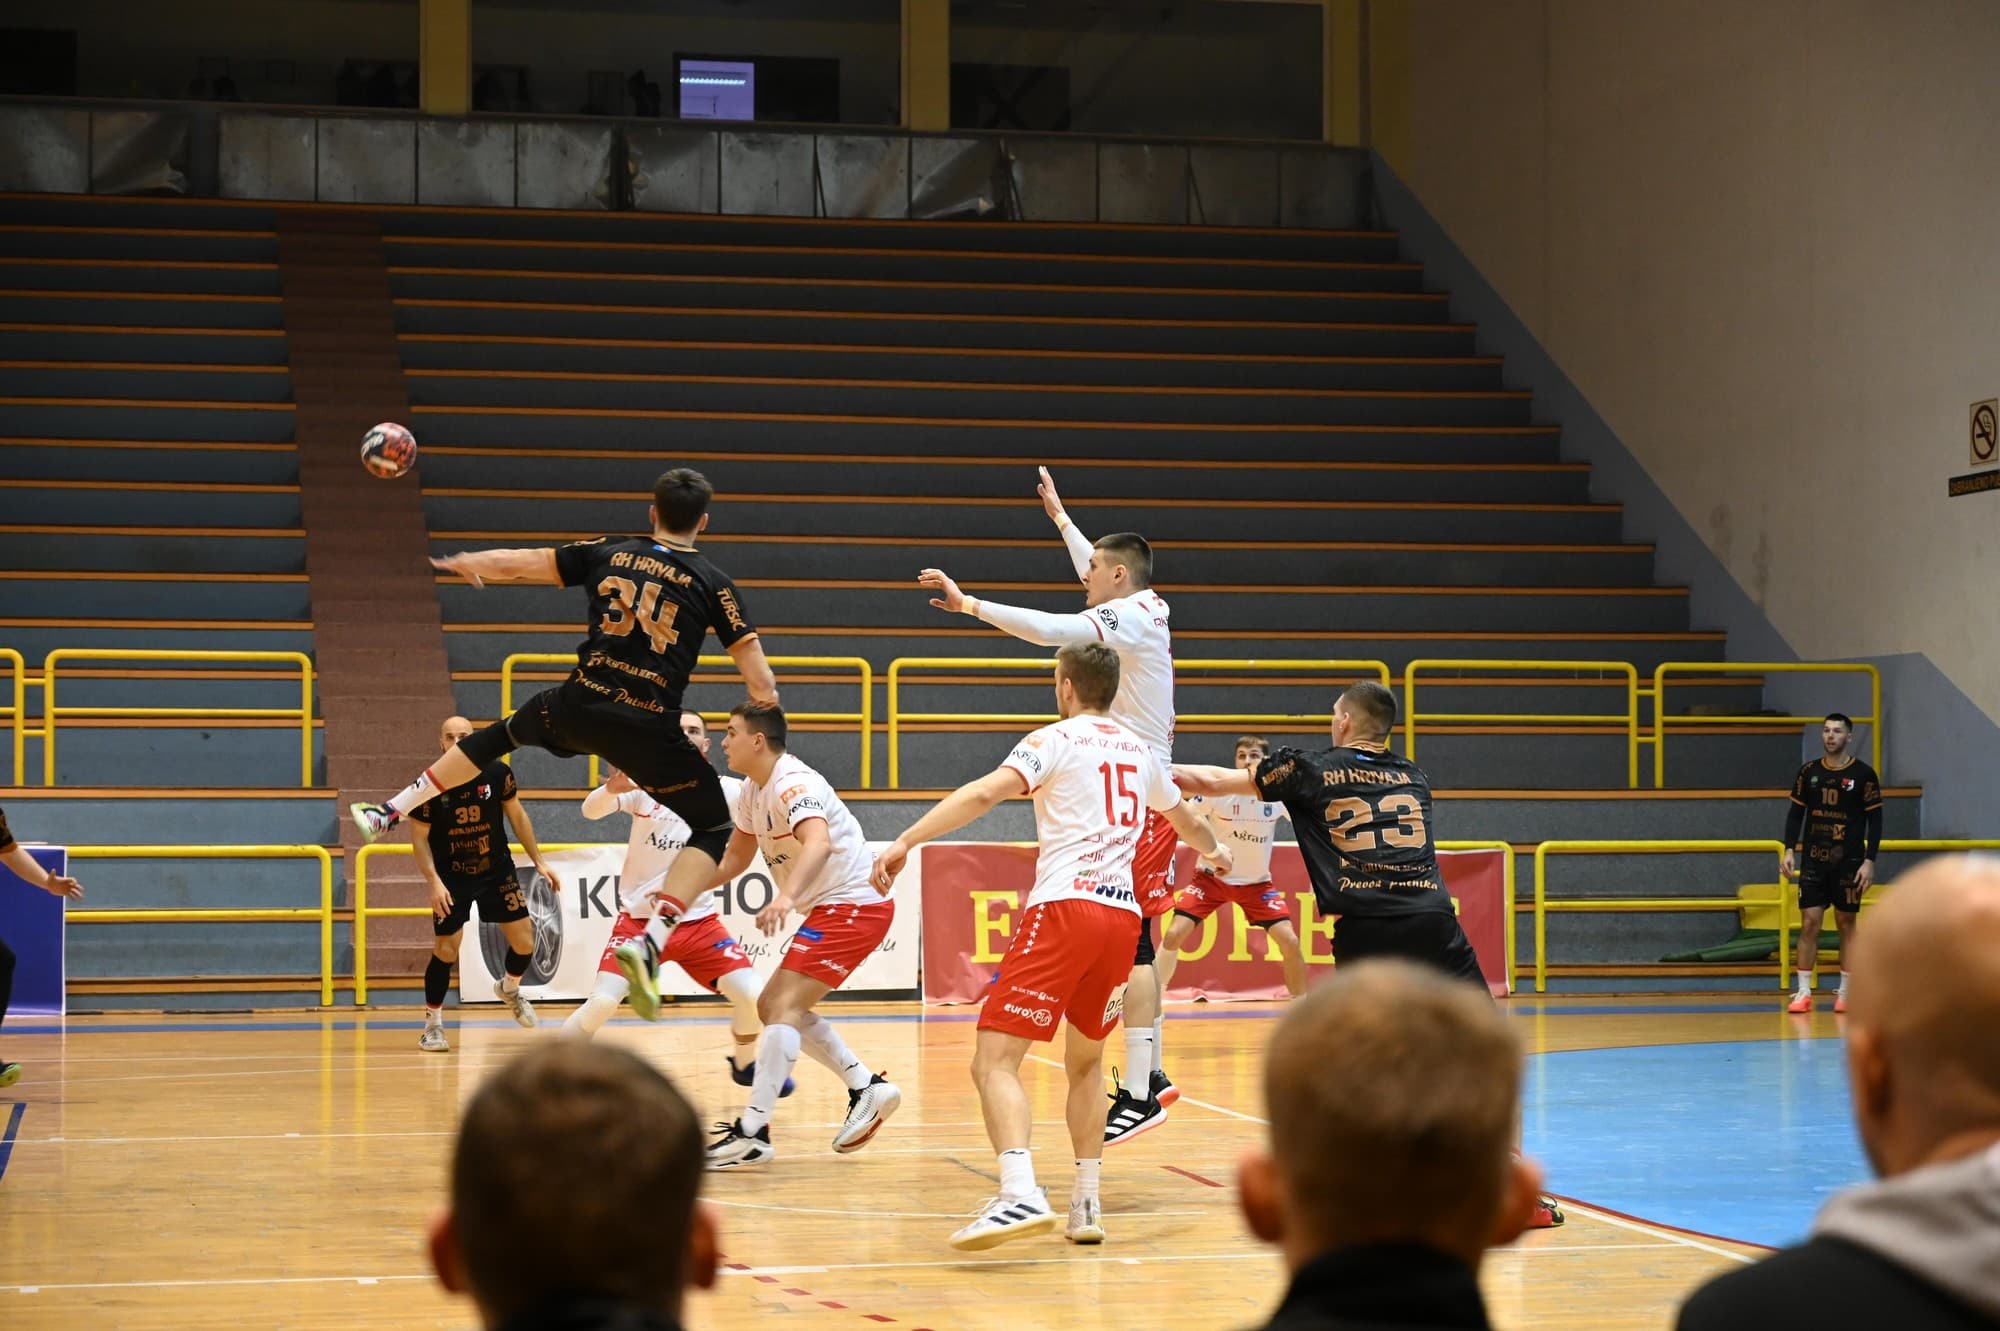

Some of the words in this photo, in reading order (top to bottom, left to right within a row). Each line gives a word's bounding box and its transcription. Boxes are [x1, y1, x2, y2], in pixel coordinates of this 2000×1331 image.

[598, 576, 680, 655] 34
[455, 805, 481, 824] 39
[1098, 761, 1139, 827] 15
[1822, 787, 1839, 805] 10
[1324, 794, 1427, 853] 23
[504, 889, 528, 912] 39
